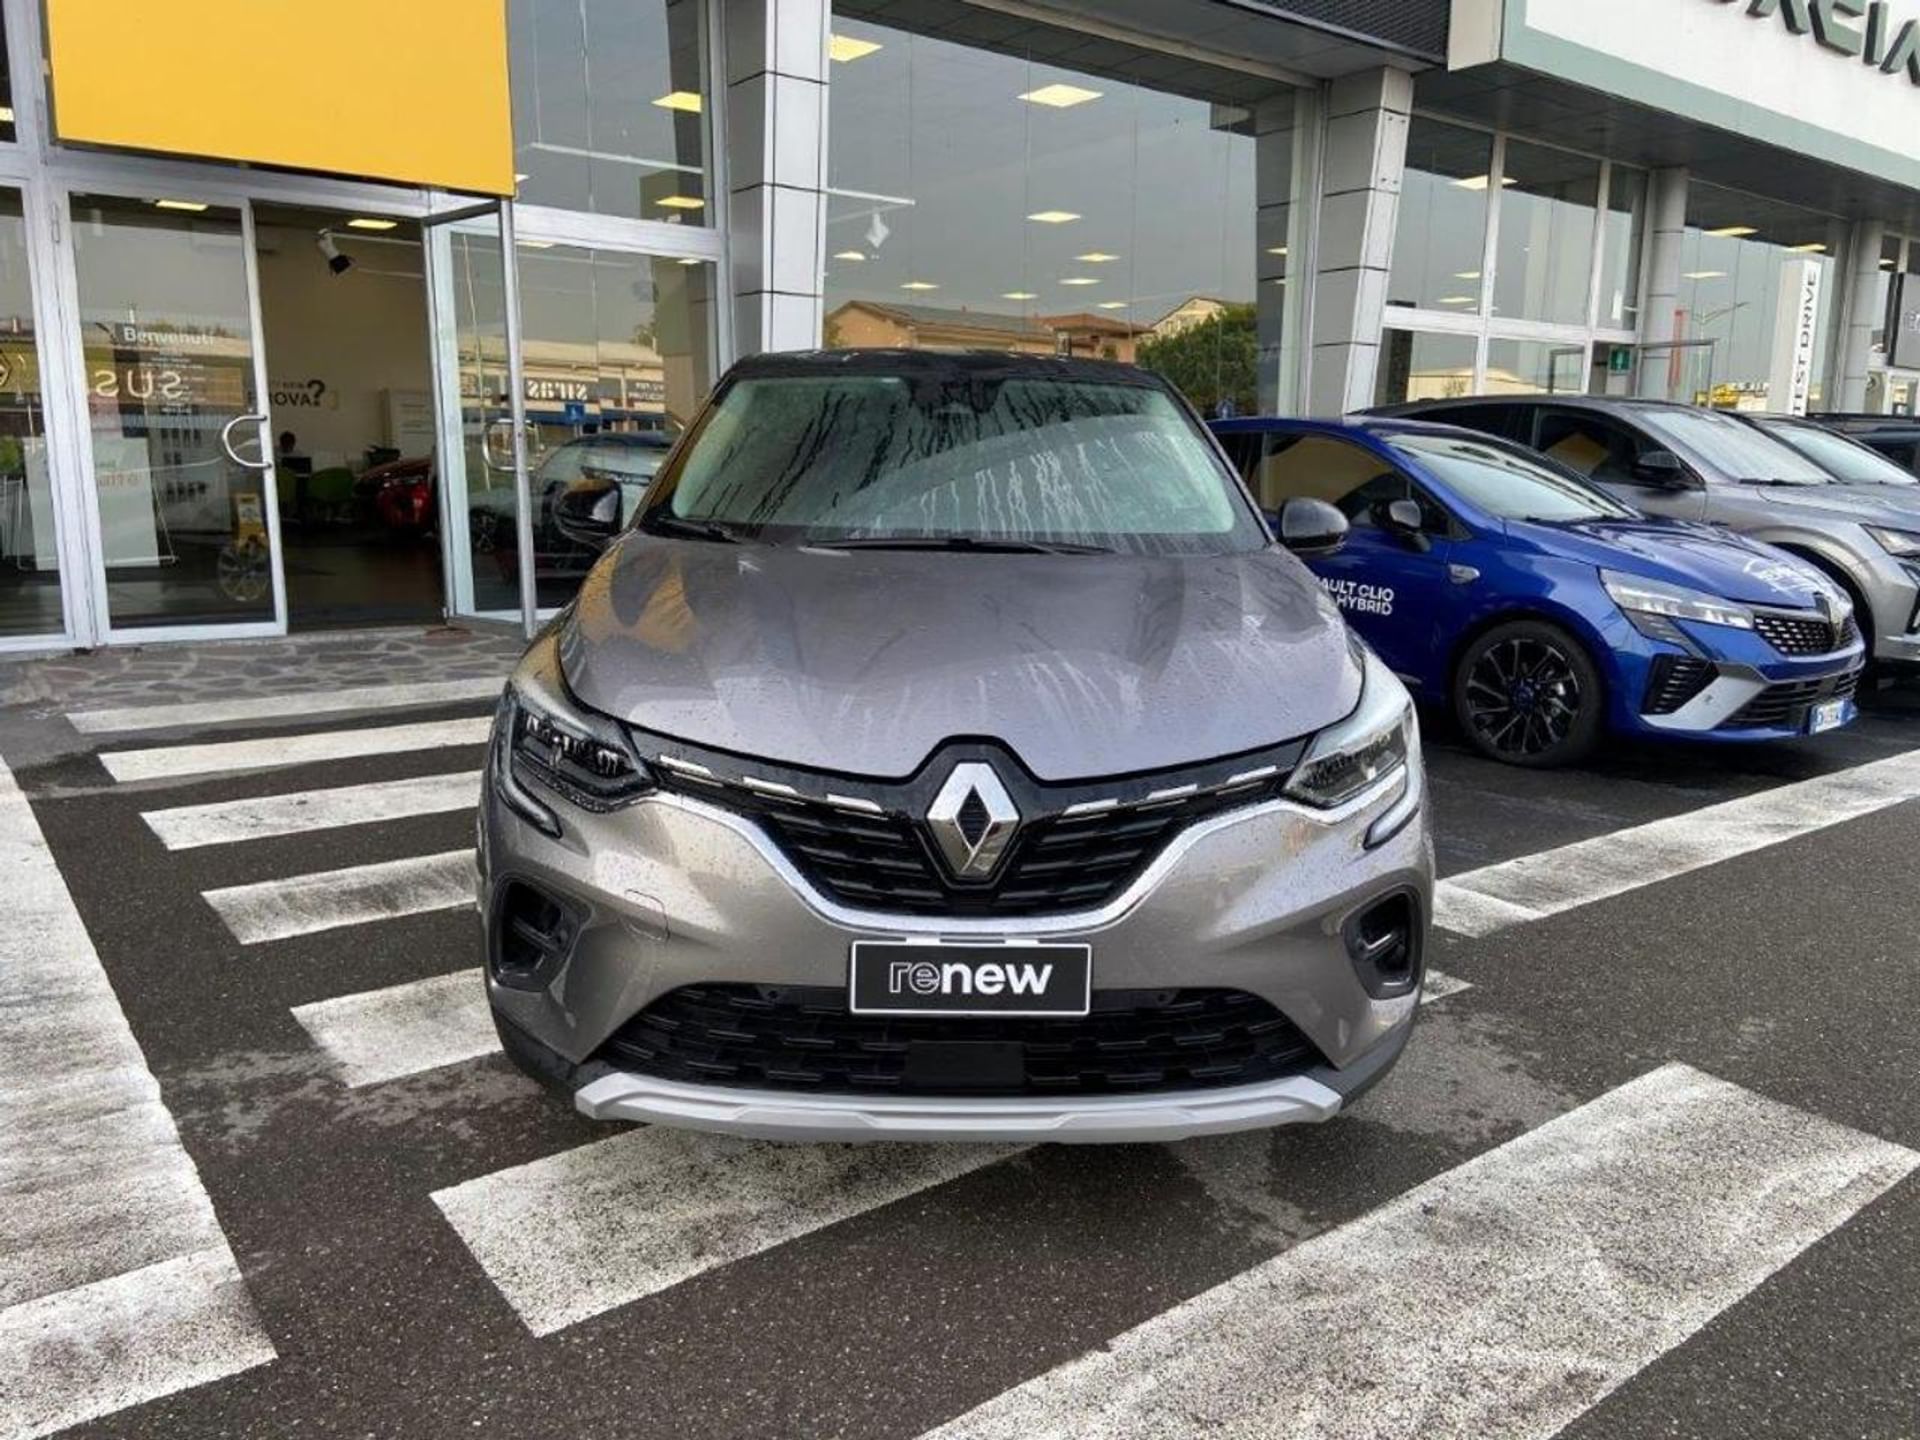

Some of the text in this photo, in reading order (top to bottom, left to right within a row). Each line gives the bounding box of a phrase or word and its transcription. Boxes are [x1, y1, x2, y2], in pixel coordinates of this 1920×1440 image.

[123, 326, 214, 345] Benvenuti
[1793, 271, 1817, 416] TEST DRIVE
[1358, 584, 1394, 602] CLIO
[1336, 594, 1392, 615] HYBRID
[889, 961, 1054, 996] renew
